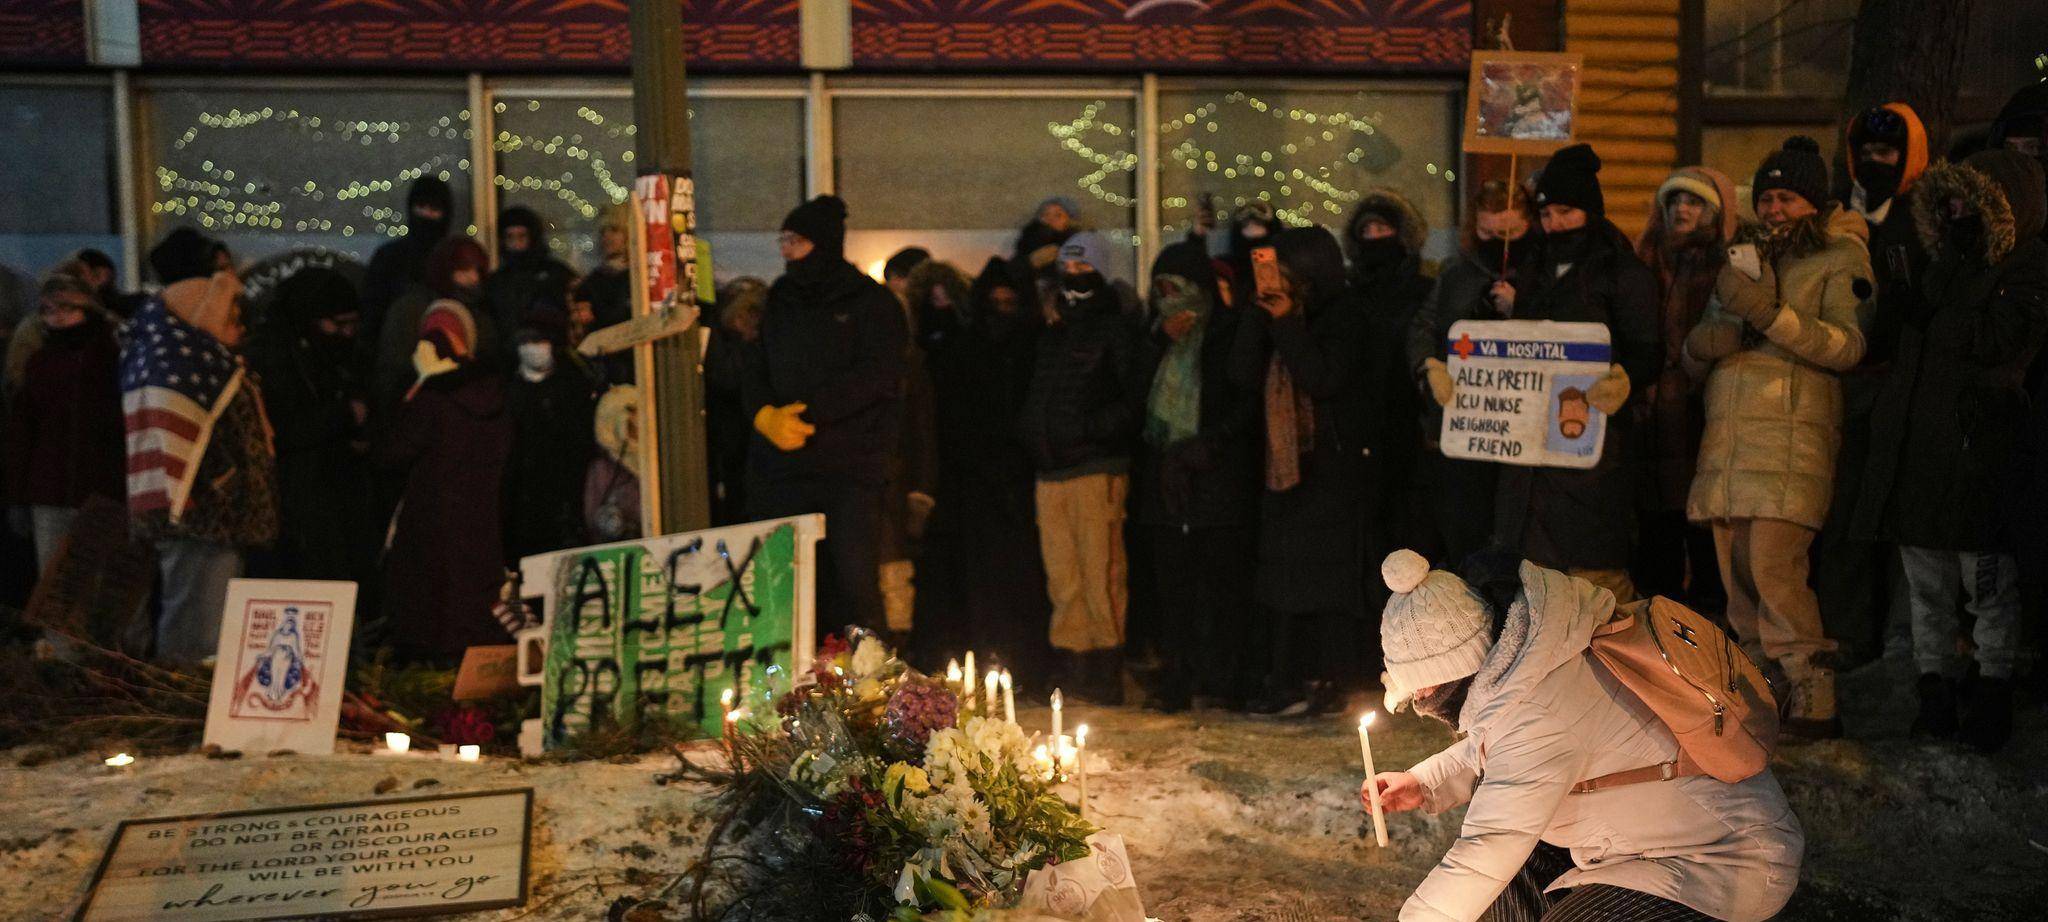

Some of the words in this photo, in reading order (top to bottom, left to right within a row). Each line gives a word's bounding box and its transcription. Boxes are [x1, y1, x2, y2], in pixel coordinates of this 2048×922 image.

[1479, 341, 1498, 356] VA
[1507, 341, 1568, 360] HOSPITAL
[1456, 366, 1494, 388] ALEX
[1497, 369, 1544, 392] PRETTI
[1456, 393, 1480, 410] ICU
[1484, 397, 1523, 415] NURSE
[1449, 416, 1510, 435] NEIGHBOR
[1468, 437, 1522, 457] FRIEND
[573, 537, 761, 635] ALEX
[147, 828, 176, 839] BE
[186, 820, 281, 838] STRONG
[304, 805, 461, 827] COURAGEOUS
[190, 837, 226, 848] DO
[234, 832, 282, 845] NOT
[291, 829, 320, 840] BE
[327, 822, 410, 838] AFRAID
[290, 842, 323, 853] OR
[332, 827, 498, 850] DISCOURAGED
[138, 865, 187, 877] FOR
[198, 860, 243, 873] THE
[251, 855, 317, 869] LORD
[325, 850, 389, 863] YOUR
[398, 844, 450, 857] GOD
[248, 869, 305, 881] WILL
[314, 866, 345, 877] BE
[352, 860, 416, 874] WITH
[424, 855, 474, 868] YOU
[162, 883, 342, 910] wherever
[349, 880, 438, 908] you
[441, 874, 502, 899] go
